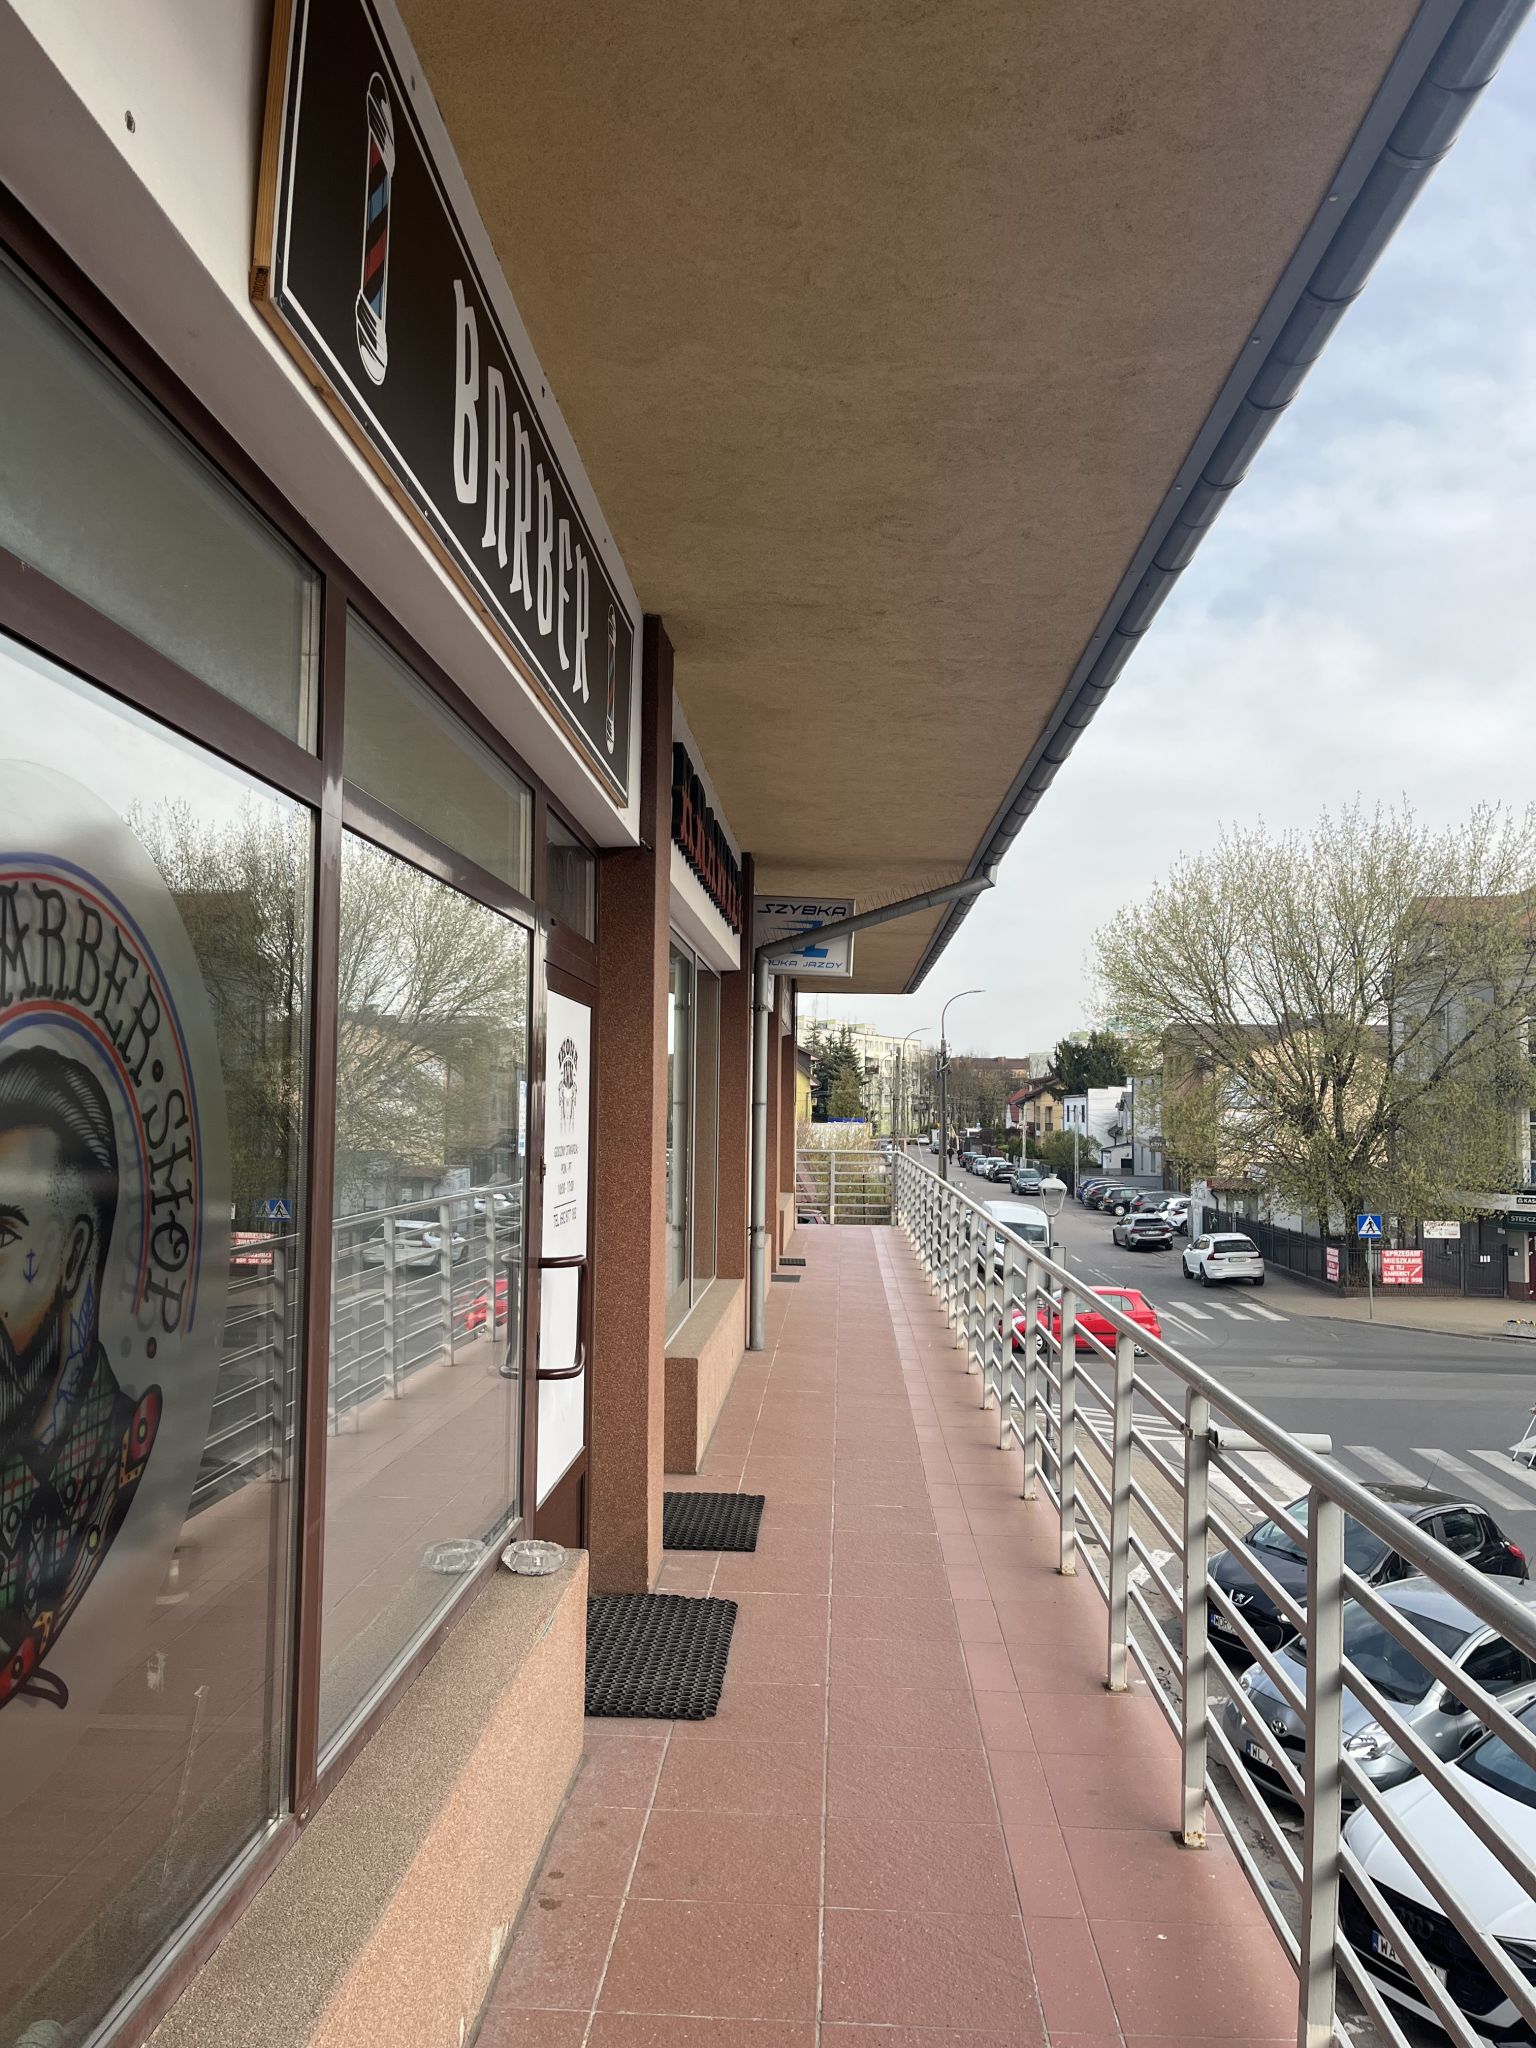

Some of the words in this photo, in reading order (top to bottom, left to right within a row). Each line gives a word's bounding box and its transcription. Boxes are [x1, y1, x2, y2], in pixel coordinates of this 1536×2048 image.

[453, 279, 589, 704] BARBER
[757, 903, 847, 917] SZYBKA
[803, 961, 843, 969] JAZDY
[142, 1088, 194, 1333] SHOP
